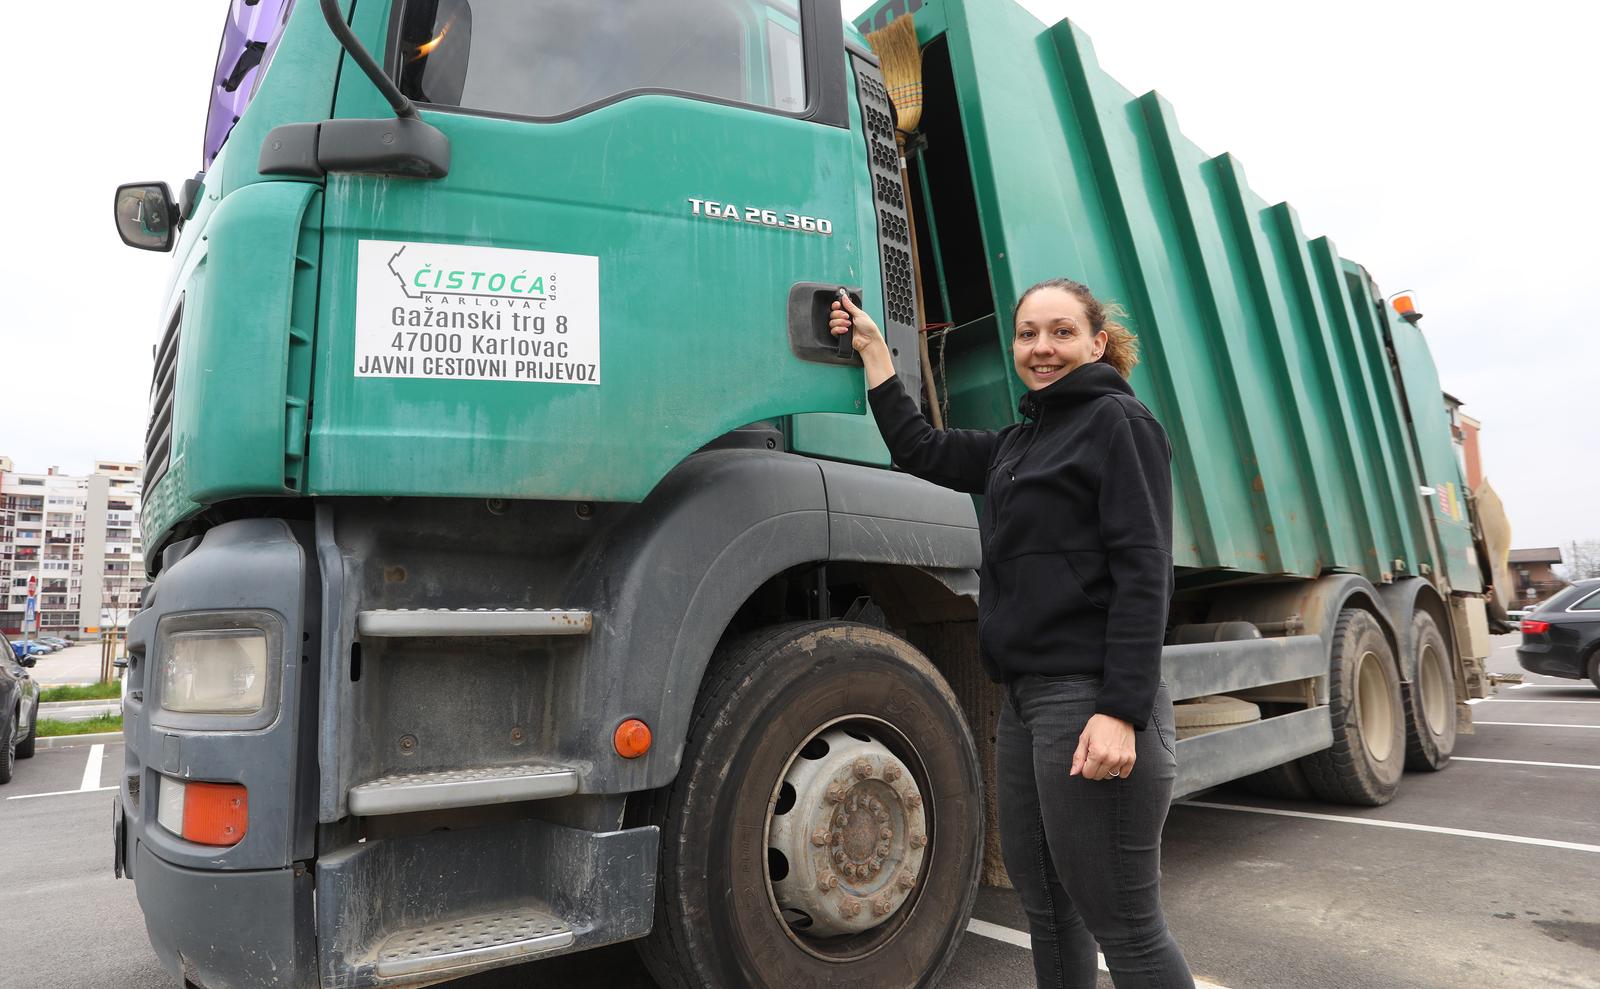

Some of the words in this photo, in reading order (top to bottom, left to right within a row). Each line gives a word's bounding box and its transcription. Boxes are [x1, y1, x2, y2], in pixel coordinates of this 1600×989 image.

[688, 198, 740, 222] TGA
[744, 206, 832, 236] 26.360
[413, 263, 545, 295] ČISTOĆA
[425, 295, 547, 310] KARLOVAC
[391, 306, 501, 330] Gažanski
[512, 312, 545, 335] trg
[556, 315, 568, 334] 8
[391, 332, 462, 353] 47000
[472, 335, 568, 358] Karlovac
[359, 356, 414, 374] JAVNI
[423, 357, 507, 377] CESTOVNI
[515, 361, 596, 382] PRIJEVOZ
